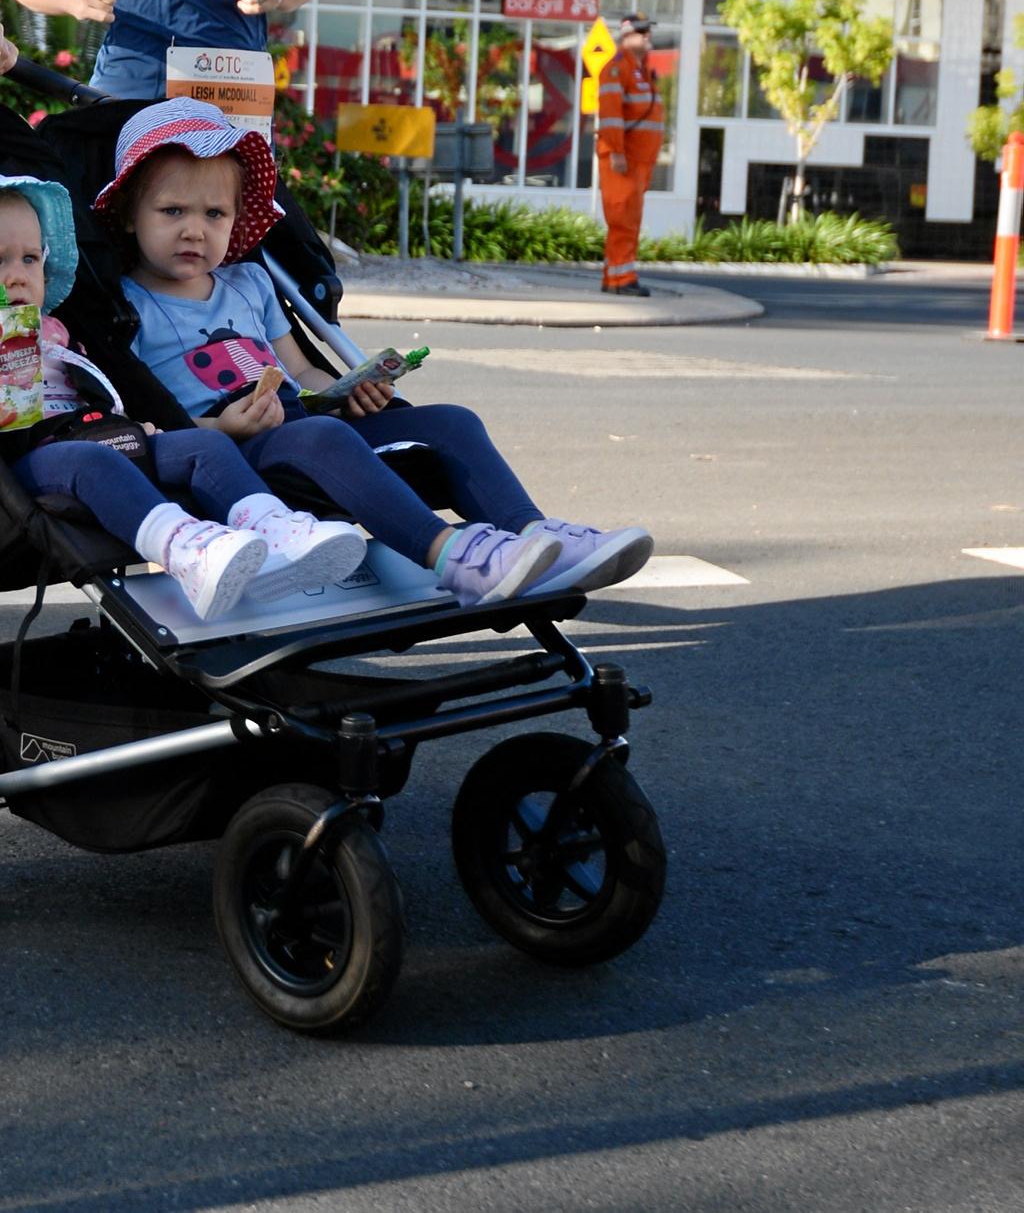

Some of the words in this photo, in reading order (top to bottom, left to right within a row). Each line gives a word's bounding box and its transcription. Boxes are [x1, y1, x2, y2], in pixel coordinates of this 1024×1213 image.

[215, 55, 241, 74] CTC
[191, 86, 215, 100] LEISH
[98, 434, 136, 445] mountain
[42, 742, 72, 754] mountain
